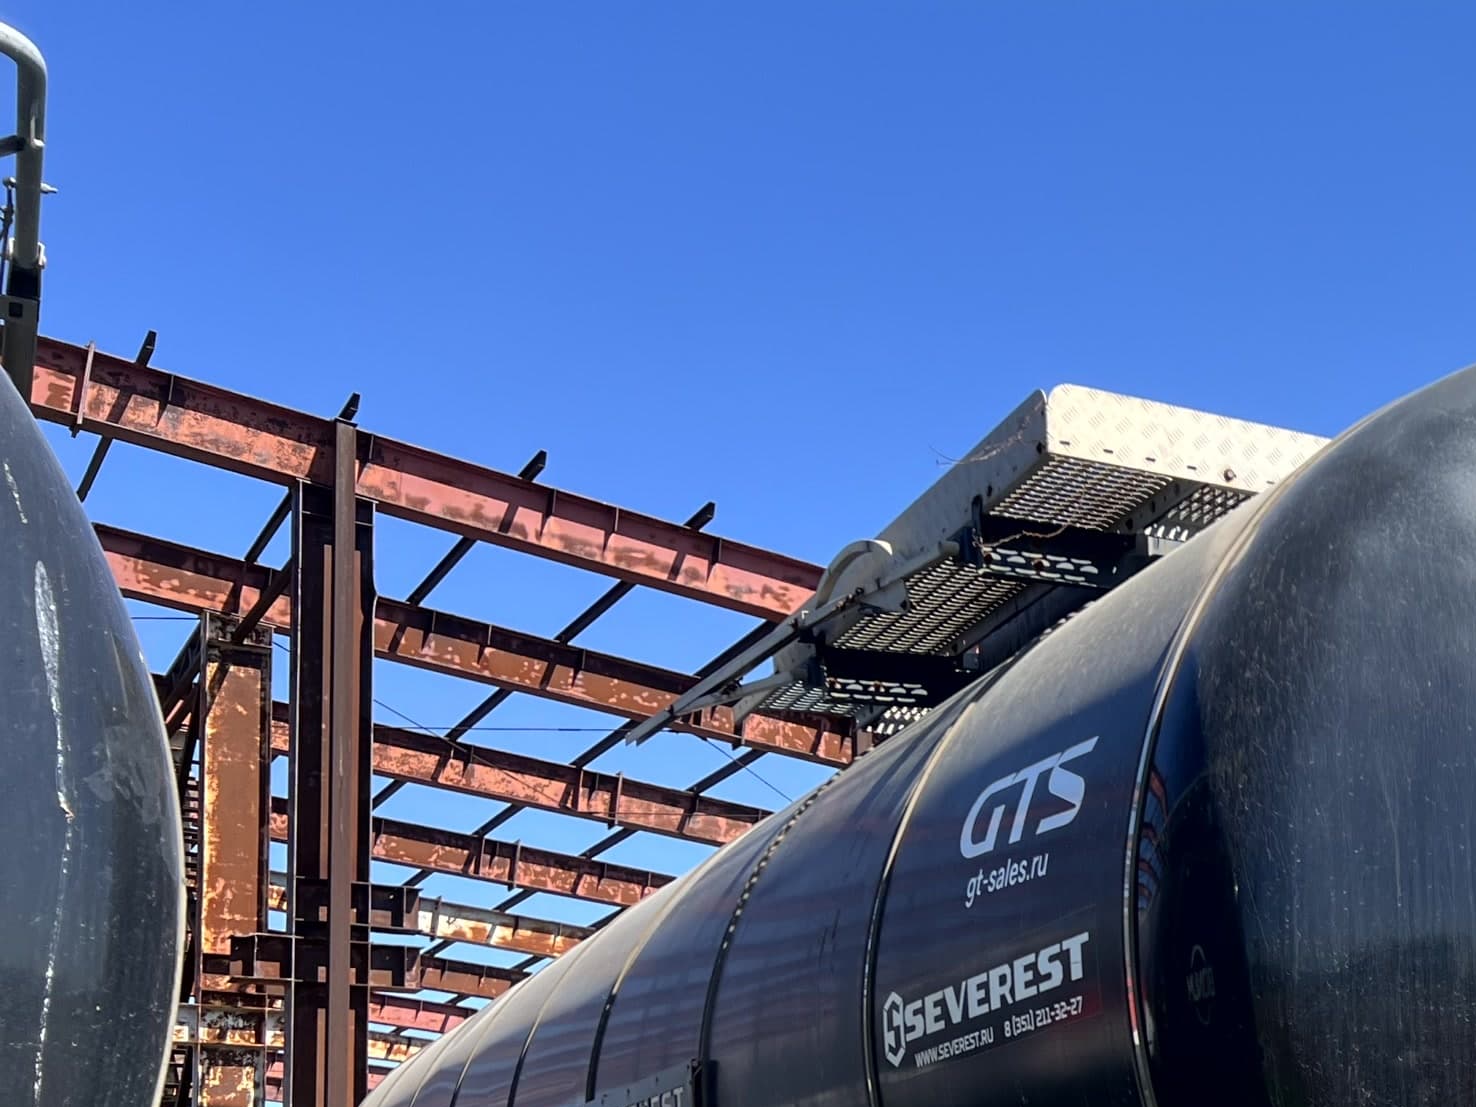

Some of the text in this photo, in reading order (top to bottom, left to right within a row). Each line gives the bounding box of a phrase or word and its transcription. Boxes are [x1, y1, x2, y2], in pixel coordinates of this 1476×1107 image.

[960, 736, 1099, 859] GTS
[965, 853, 1049, 908] gt-sales.ru
[904, 931, 1089, 1042] SEVEREST
[914, 996, 1083, 1068] WWW.SEVEREST.RU 8 (351) 211-32-27
